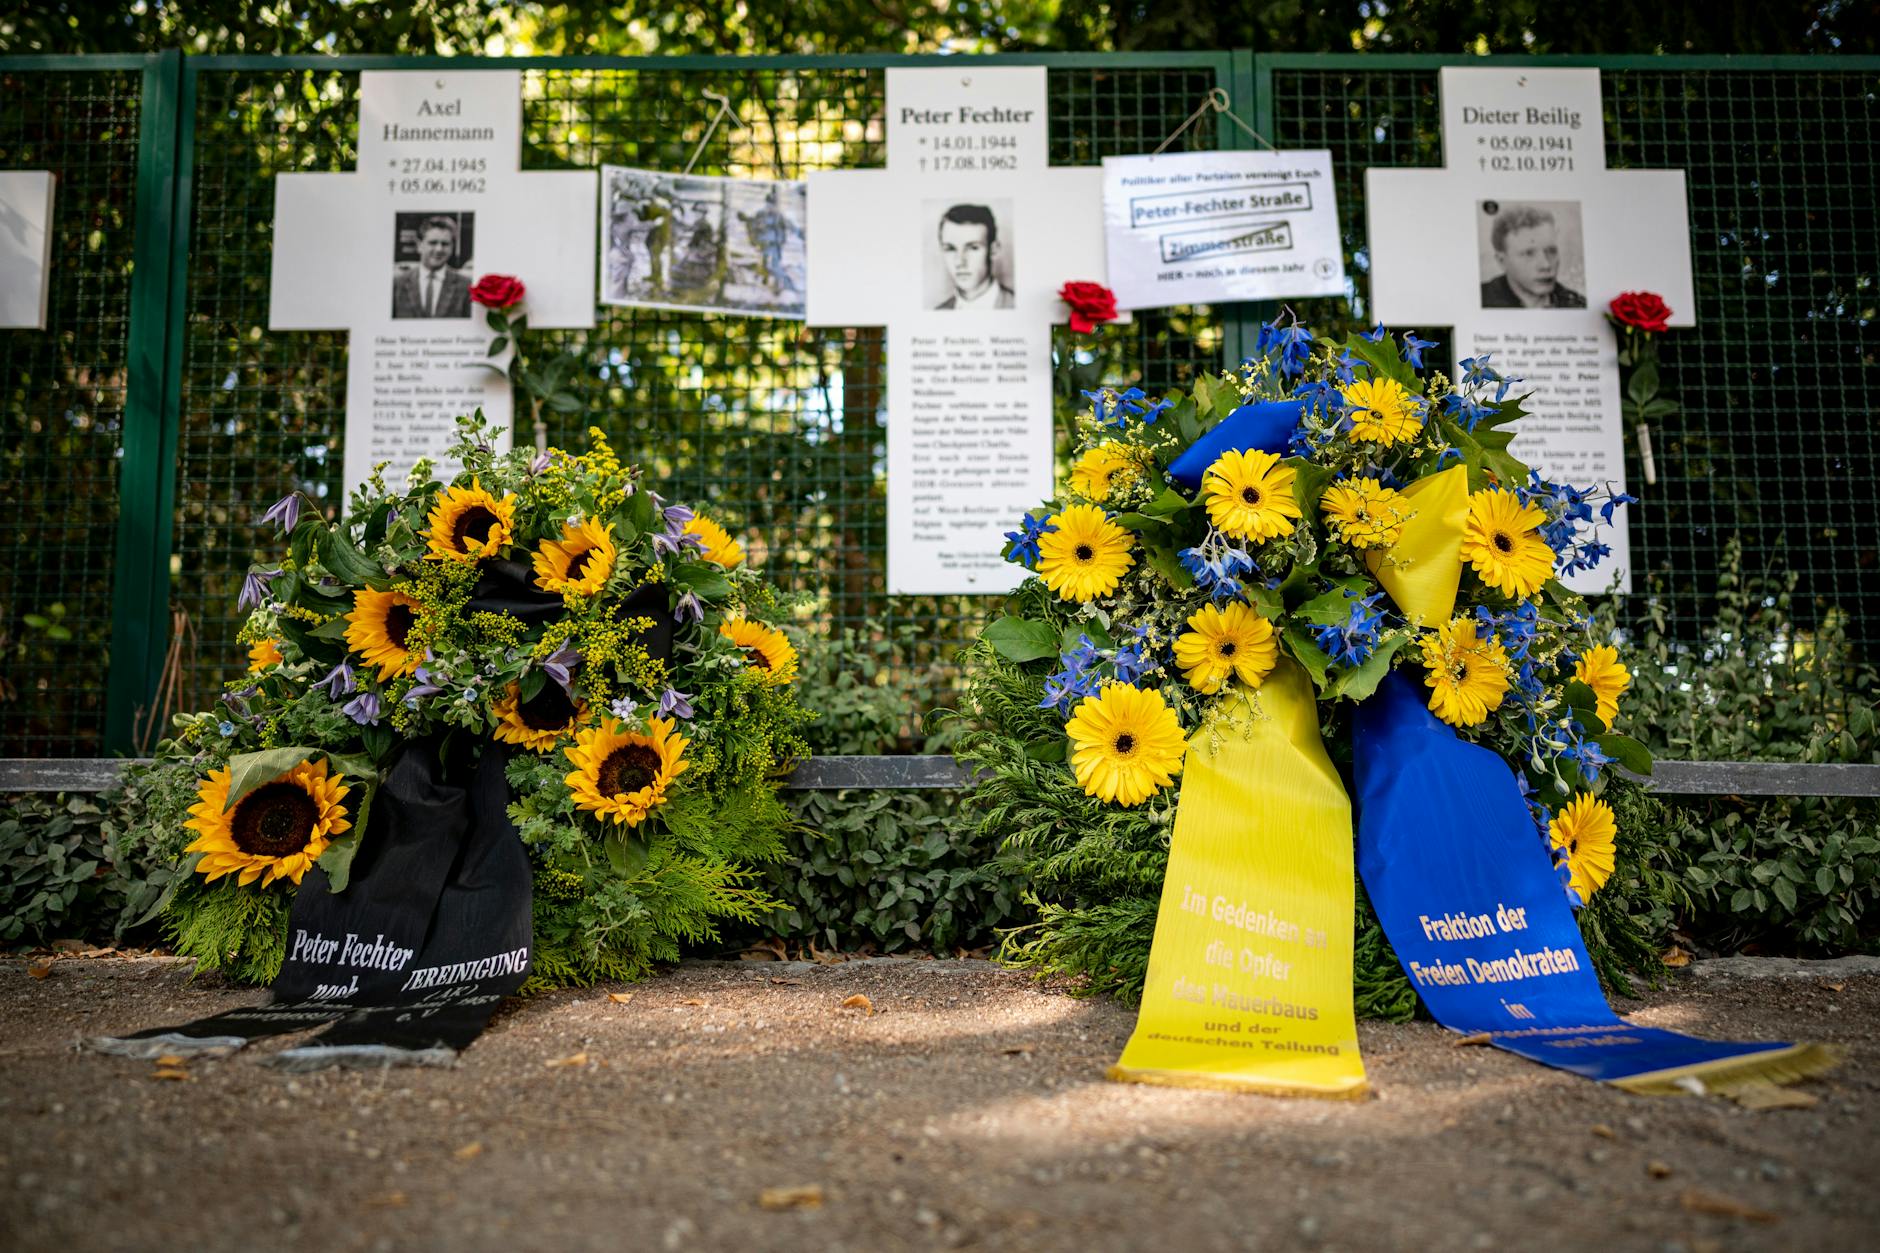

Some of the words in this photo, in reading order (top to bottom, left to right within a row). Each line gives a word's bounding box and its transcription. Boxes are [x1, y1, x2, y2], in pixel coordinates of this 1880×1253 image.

[417, 99, 461, 116] Axel
[901, 107, 952, 124] Peter
[959, 107, 1033, 124] Fechter
[1462, 106, 1520, 125] Dieter
[1526, 106, 1581, 129] Beilig
[383, 124, 494, 141] Hannemann
[933, 136, 1016, 150] 14.01.1944
[1490, 136, 1573, 151] 05.09.1941
[402, 158, 486, 173] 27.04.1945
[934, 156, 1017, 170] 17.08.1962
[1491, 157, 1573, 171] 02.10.1971
[401, 179, 486, 193] 05.06.1962
[1121, 174, 1166, 187] Politiker
[1170, 172, 1193, 184] aller
[1196, 170, 1242, 183] Parteien
[1245, 169, 1293, 182] vereinigt
[1295, 167, 1322, 180] Euch
[1135, 195, 1245, 221] Peter-Fechter
[1250, 190, 1303, 209] Straße
[1170, 229, 1285, 256] Zimmerstraße
[1157, 271, 1184, 282] HIER
[1195, 267, 1224, 280] noch
[1240, 264, 1279, 276] diesem
[1283, 262, 1306, 274] Jahr
[1211, 895, 1300, 941] Gedenken
[1304, 926, 1327, 950] an
[1418, 910, 1496, 943] Fraktion
[1496, 902, 1528, 932] der
[290, 929, 339, 965] Peter
[338, 933, 414, 971] Fechter
[1206, 938, 1233, 969] die
[1239, 948, 1293, 983] Opfer
[1409, 956, 1471, 987] Freien
[1465, 946, 1579, 984] Demokraten
[1172, 976, 1206, 1004] des
[1211, 983, 1319, 1022] Mauerbaus
[1499, 998, 1535, 1020] im
[1204, 1020, 1241, 1034] und
[1247, 1023, 1281, 1035] der
[1147, 1032, 1254, 1049] deutschen
[1260, 1040, 1341, 1057] Teilung
